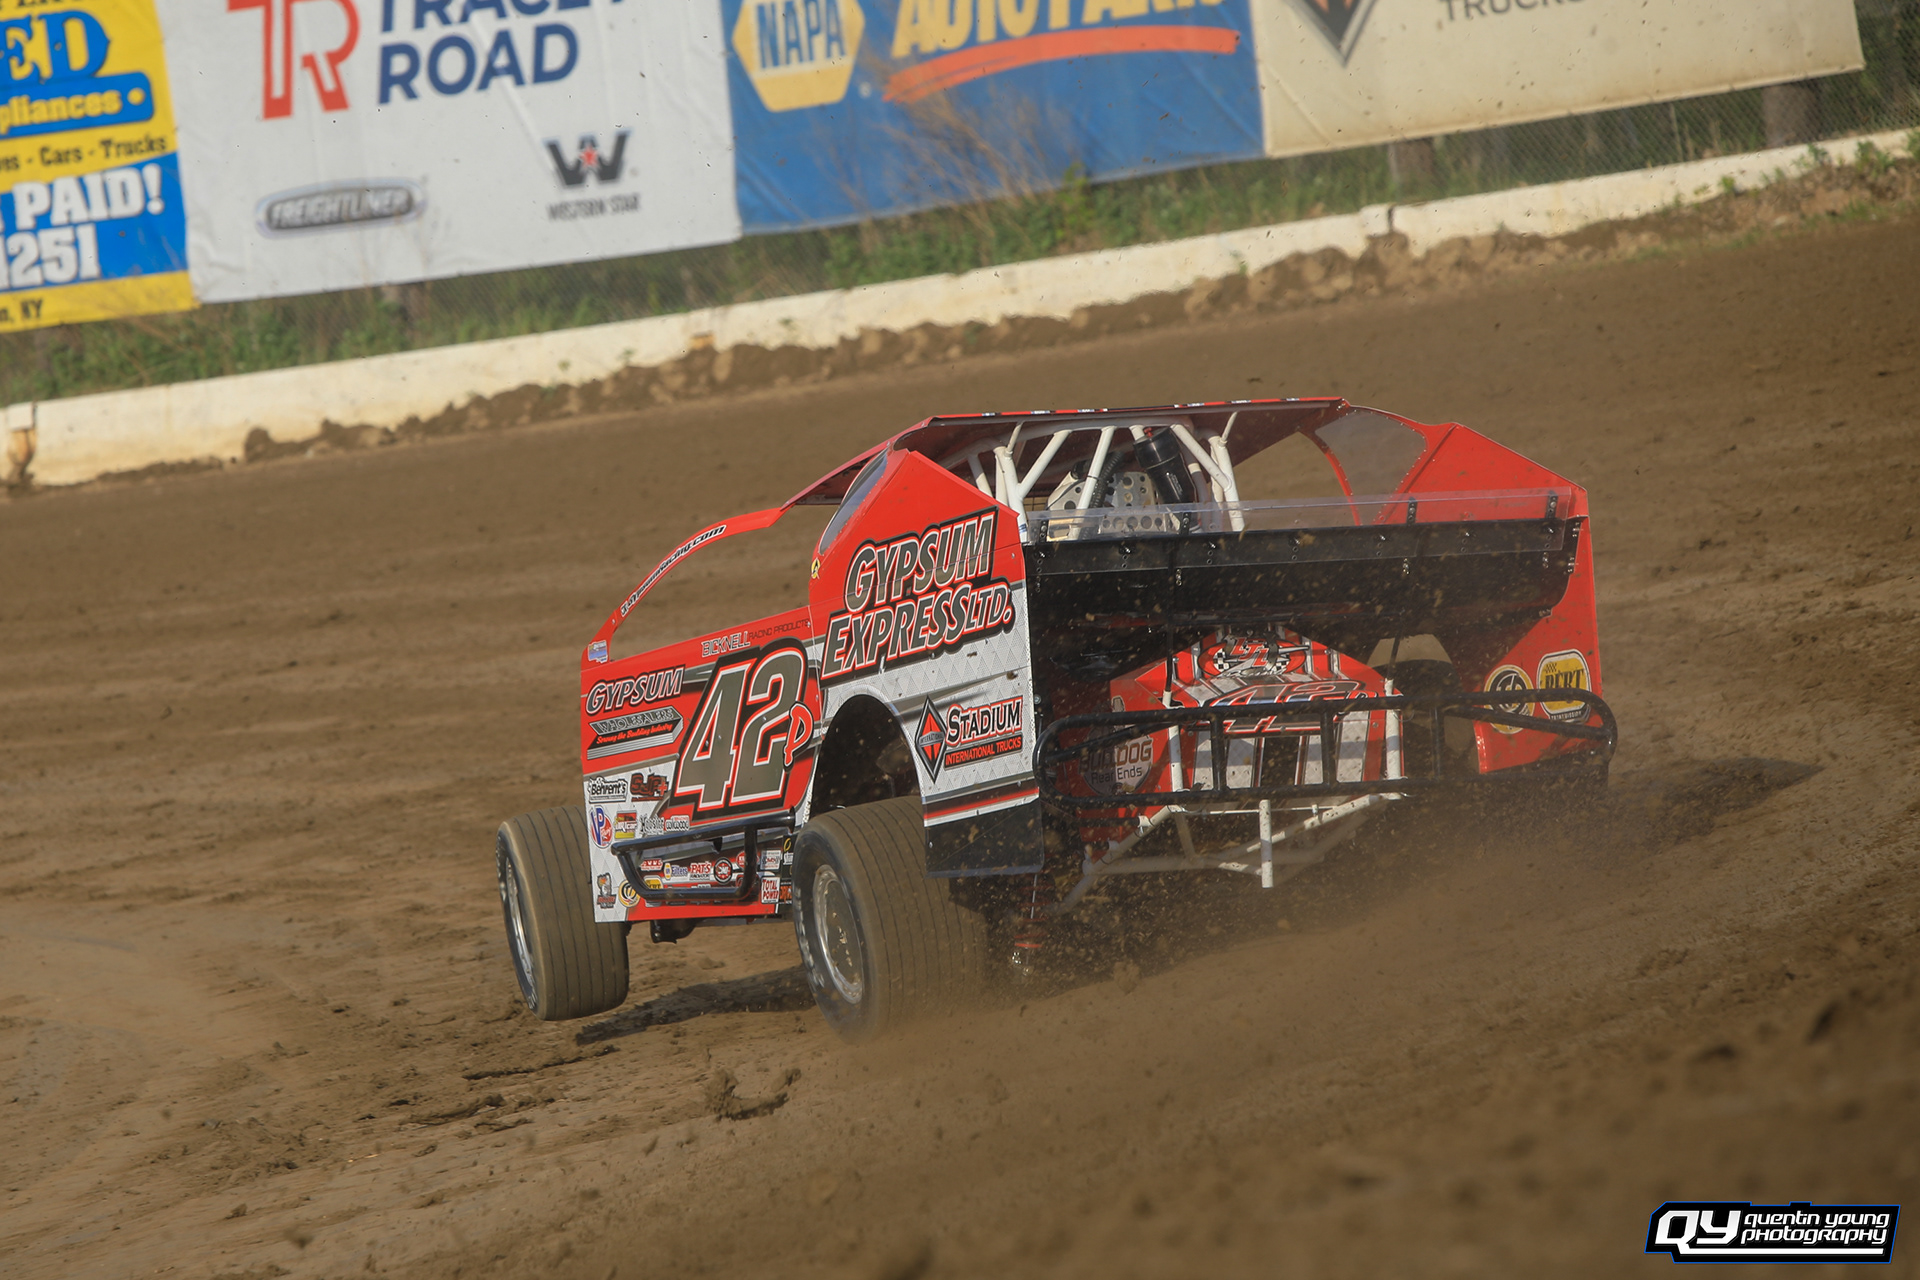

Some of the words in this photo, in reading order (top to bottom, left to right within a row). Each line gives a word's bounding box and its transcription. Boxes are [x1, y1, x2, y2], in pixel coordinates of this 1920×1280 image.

[756, 0, 846, 69] NAPA
[377, 22, 580, 105] ROAD
[40, 146, 83, 166] Cars
[99, 136, 168, 160] Trucks
[12, 163, 165, 232] PAID!
[20, 298, 43, 319] NY
[845, 511, 997, 613] GYPSUM
[701, 631, 751, 658] BICKNELL
[749, 628, 773, 640] RACING
[773, 618, 812, 635] PRODUCTS
[586, 667, 684, 715] GYPSUM
[597, 709, 674, 734] WHOLESALERS
[650, 723, 674, 733] Industry
[946, 696, 1022, 745] STADIUM
[945, 743, 995, 766] INTERNATIONAL
[996, 737, 1022, 753] TRUCKS
[590, 781, 627, 796] Behrent's
[1091, 770, 1115, 787] Rear
[1116, 765, 1143, 780] Ends
[591, 808, 605, 846] VP
[671, 864, 689, 876] Filters
[690, 861, 712, 874] PAT'S
[763, 879, 778, 890] TOTAL
[763, 890, 779, 900] POWER
